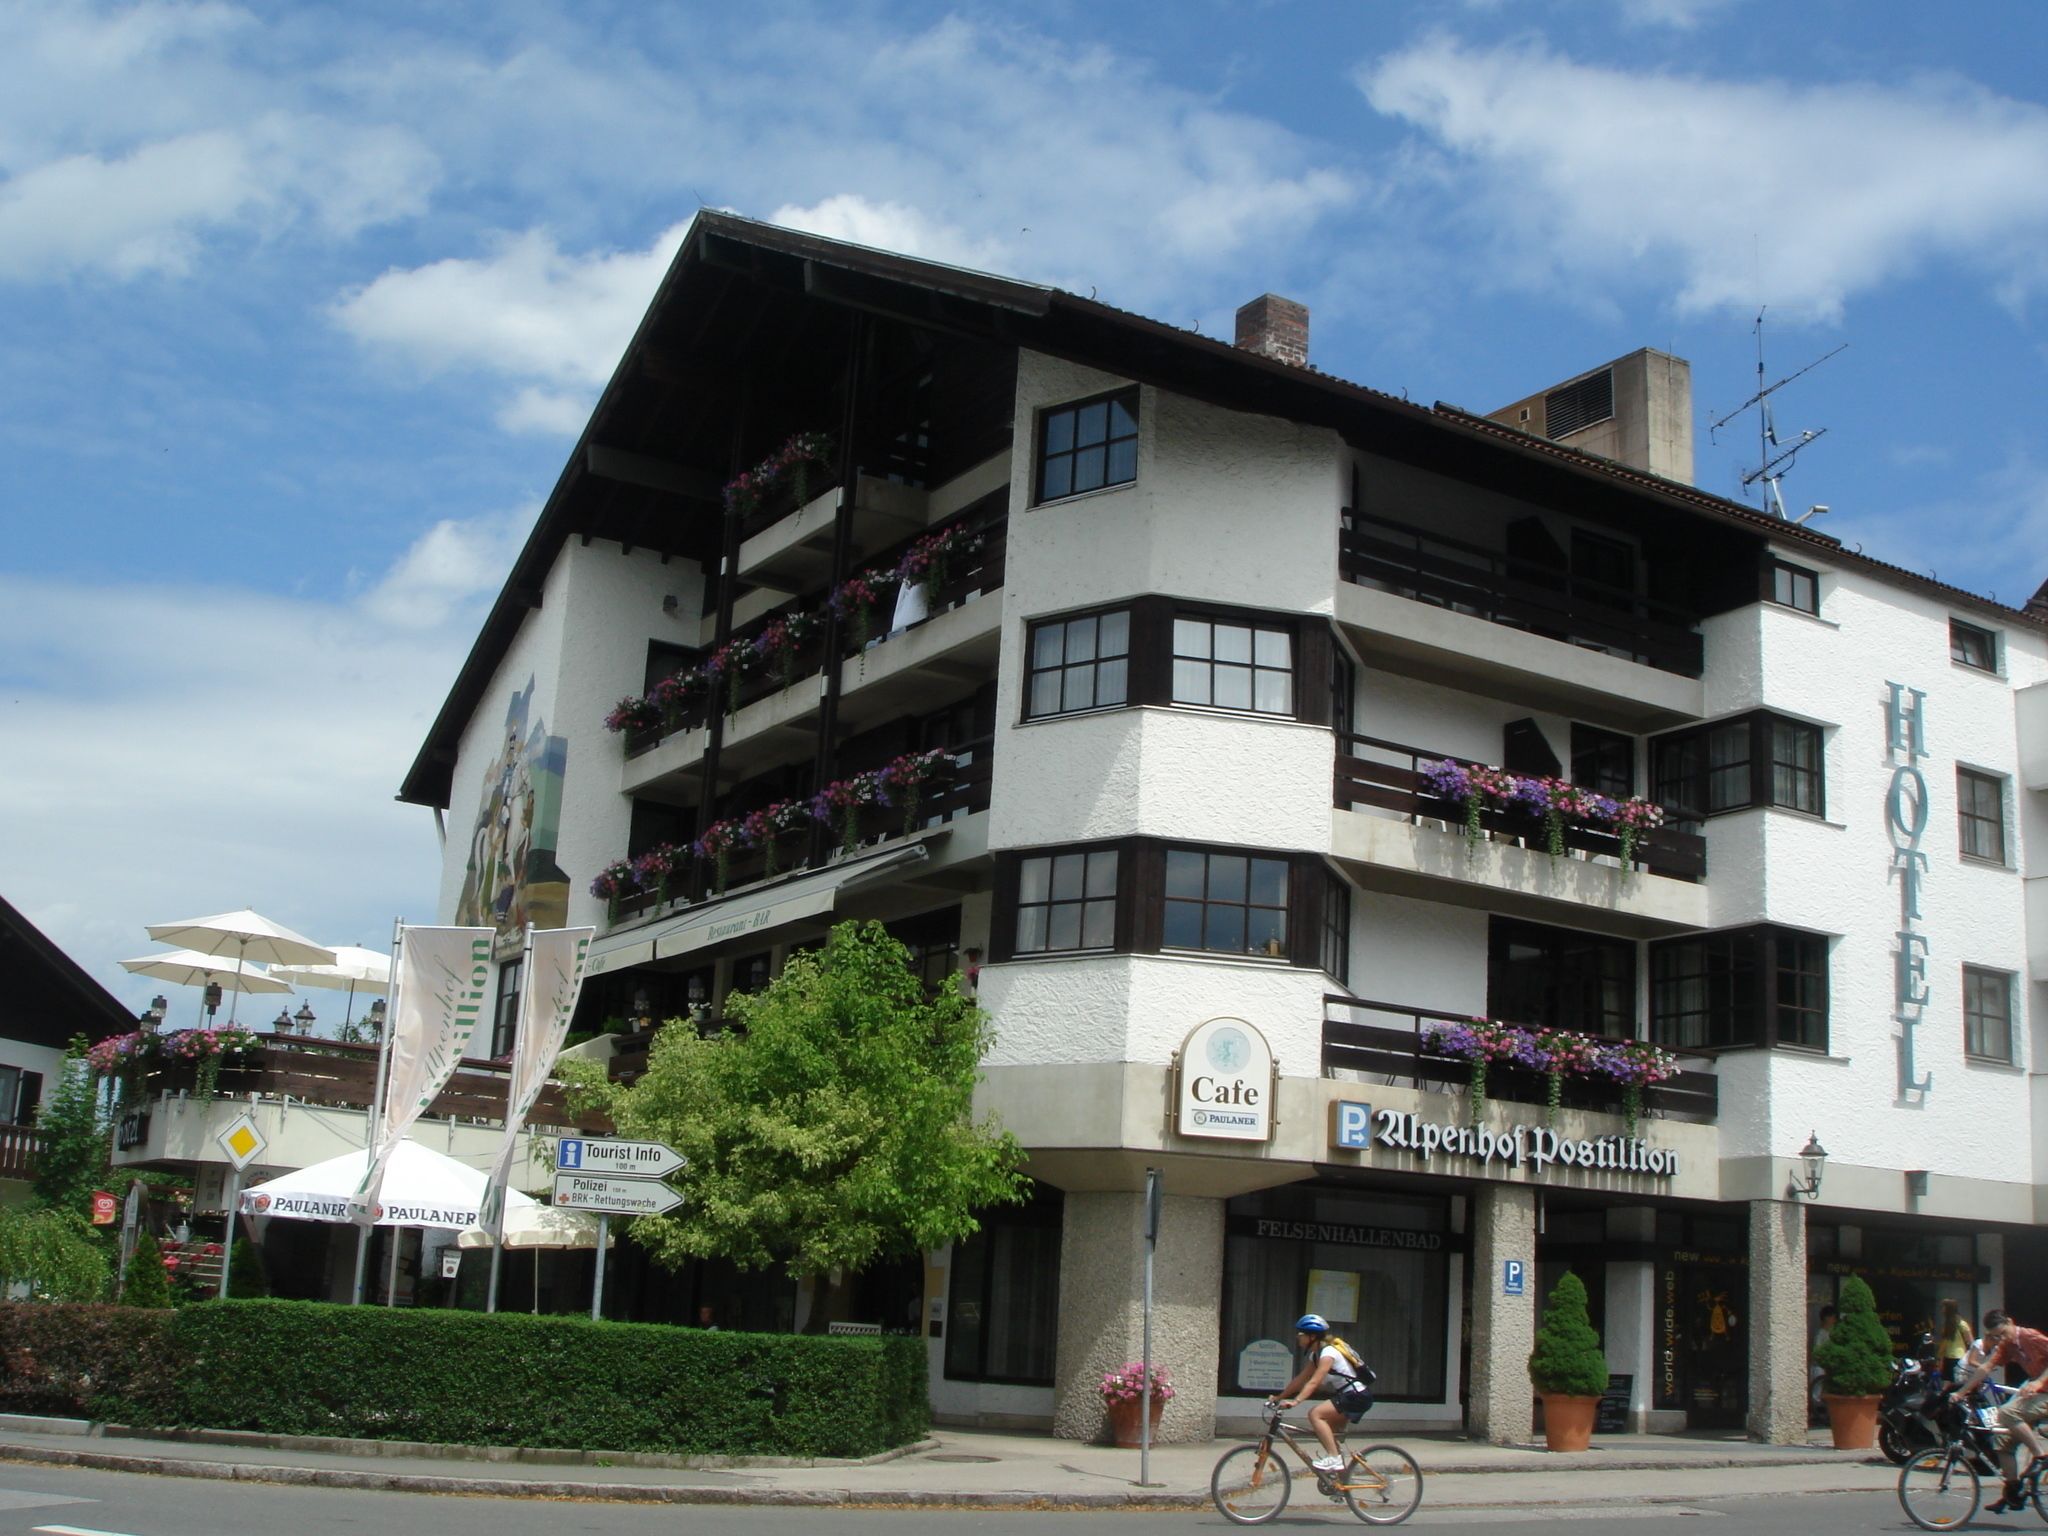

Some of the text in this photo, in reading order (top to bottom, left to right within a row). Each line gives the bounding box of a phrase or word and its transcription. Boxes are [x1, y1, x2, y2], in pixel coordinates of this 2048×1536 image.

[1885, 680, 1932, 1090] HOTEL
[1191, 1076, 1259, 1106] Cafe
[1209, 1114, 1257, 1125] PAULANER
[1376, 1109, 1681, 1176] Alpenhof Postillion
[586, 1144, 661, 1162] Tourist Info
[616, 1162, 628, 1170] 100
[573, 1179, 608, 1192] Polizei
[274, 1197, 346, 1217] PAULANER
[571, 1193, 657, 1208] BRK-Rettungswache
[388, 1206, 477, 1226] PAULANER
[1257, 1219, 1441, 1249] FELSENHALLENBAD
[1674, 1251, 1699, 1262] new
[1509, 1262, 1520, 1281] P
[1664, 1271, 1675, 1396] world.wide.web
